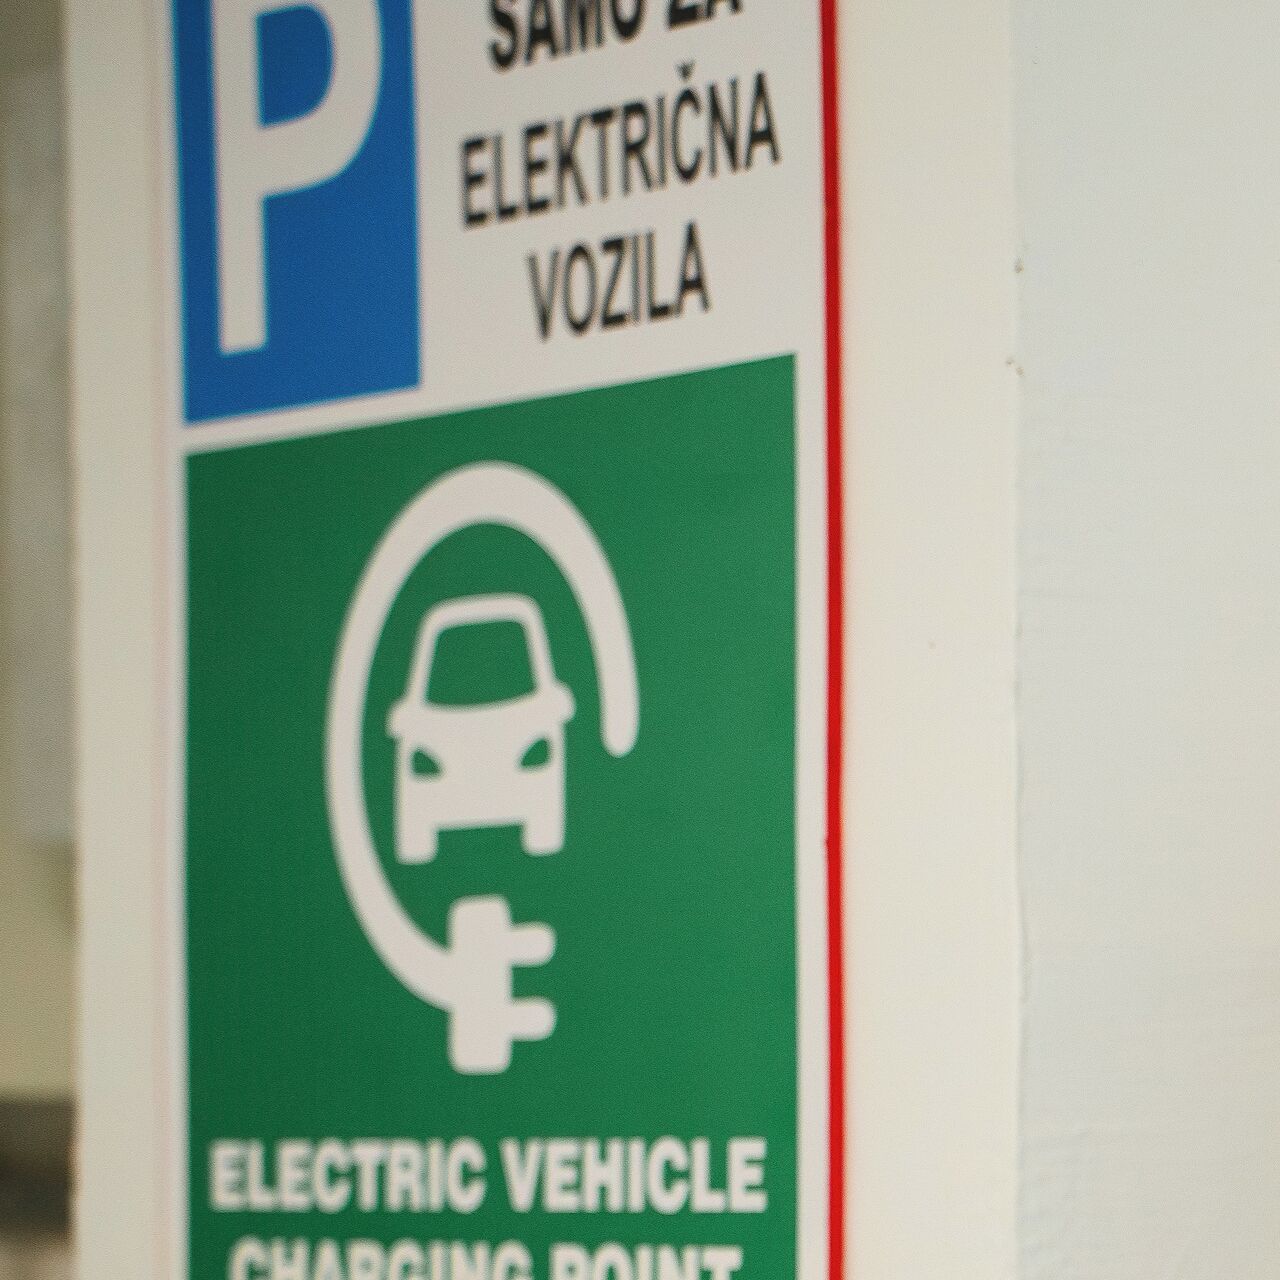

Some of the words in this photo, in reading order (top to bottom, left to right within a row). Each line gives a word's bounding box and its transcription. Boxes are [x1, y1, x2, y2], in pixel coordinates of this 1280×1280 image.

[210, 0, 383, 354] P
[459, 62, 781, 230] ELEKTRIČNA
[528, 222, 711, 341] VOZILA
[209, 1137, 487, 1214] ELECTRIC
[501, 1136, 768, 1214] VEHICLE
